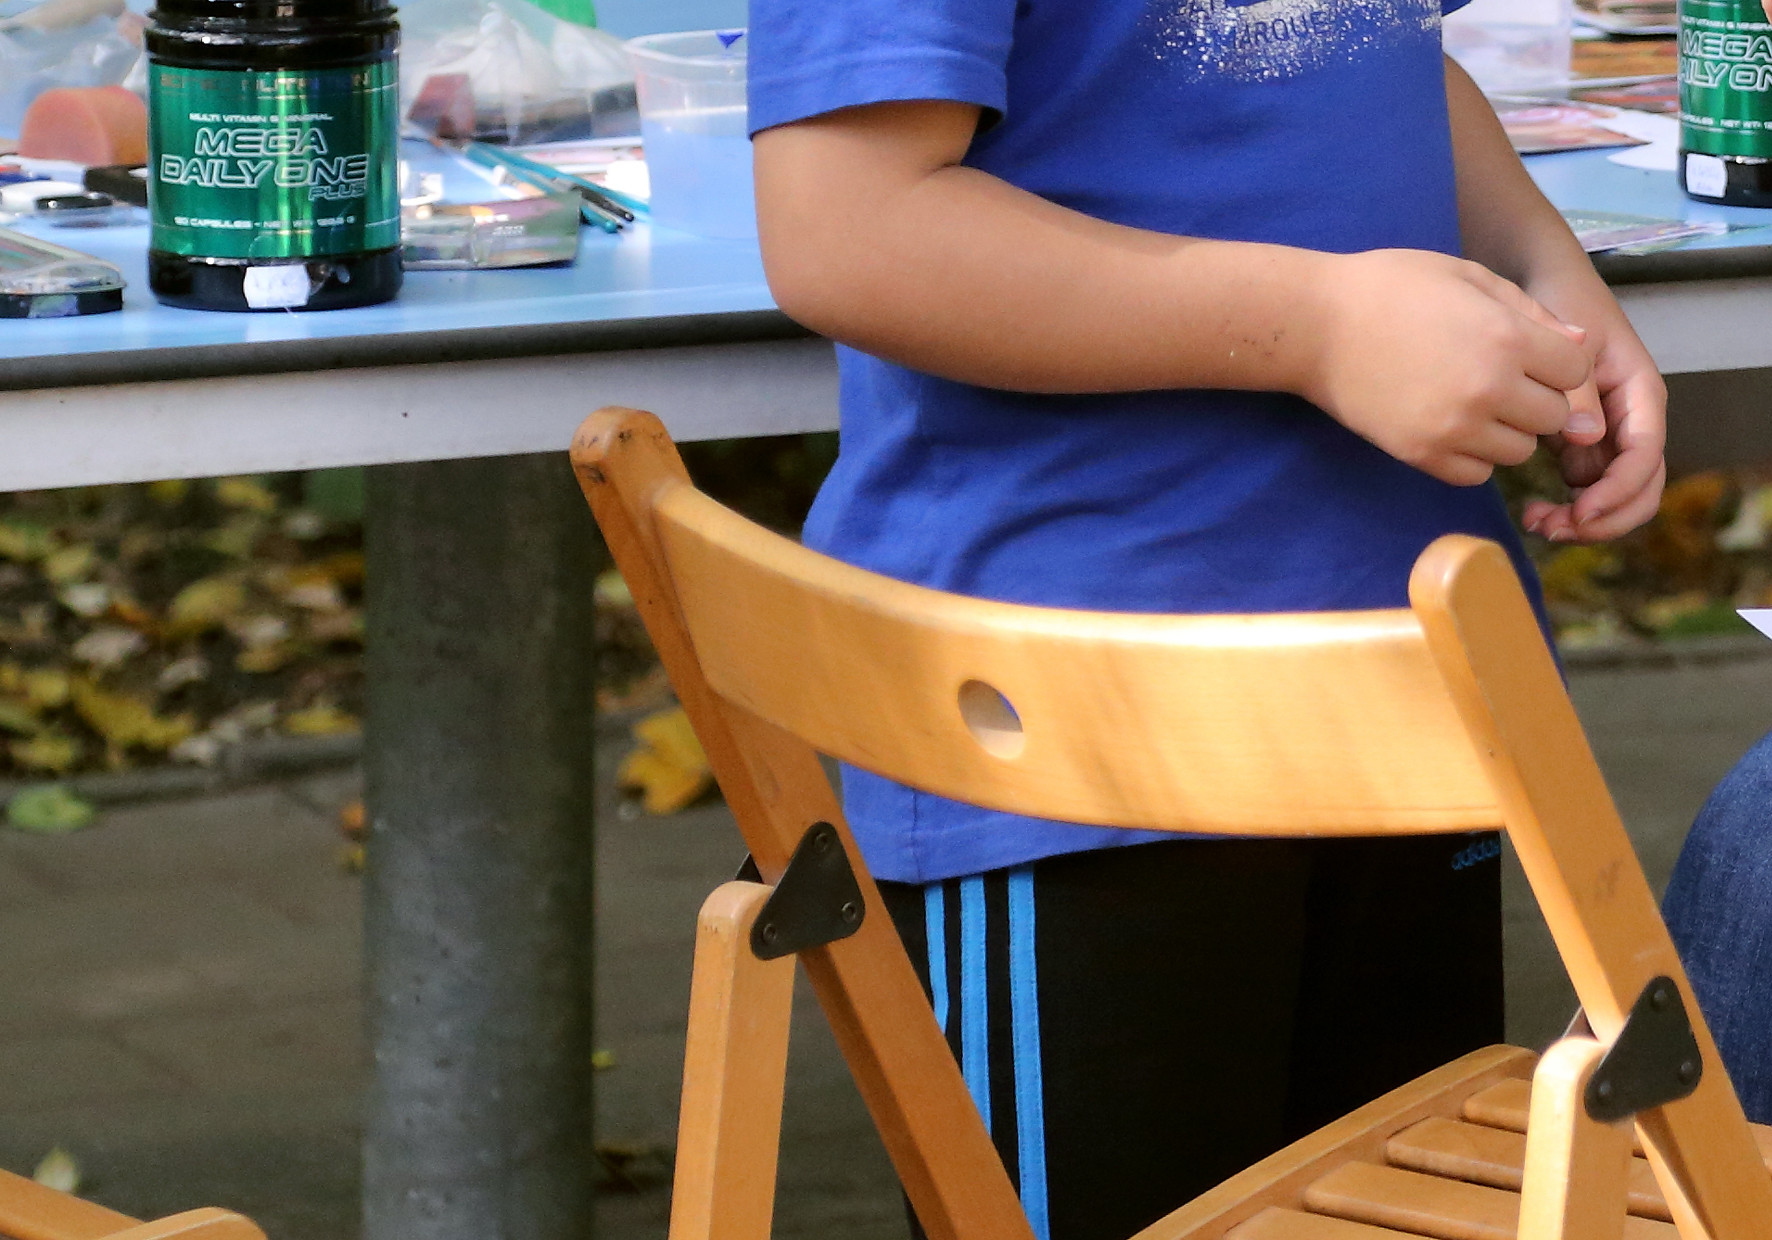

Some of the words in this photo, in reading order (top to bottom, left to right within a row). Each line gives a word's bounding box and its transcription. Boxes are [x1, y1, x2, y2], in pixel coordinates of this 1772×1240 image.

[195, 127, 328, 156] MEGA
[160, 154, 274, 188] DAILY
[275, 153, 370, 187] ONE
[308, 184, 367, 202] PLUS
